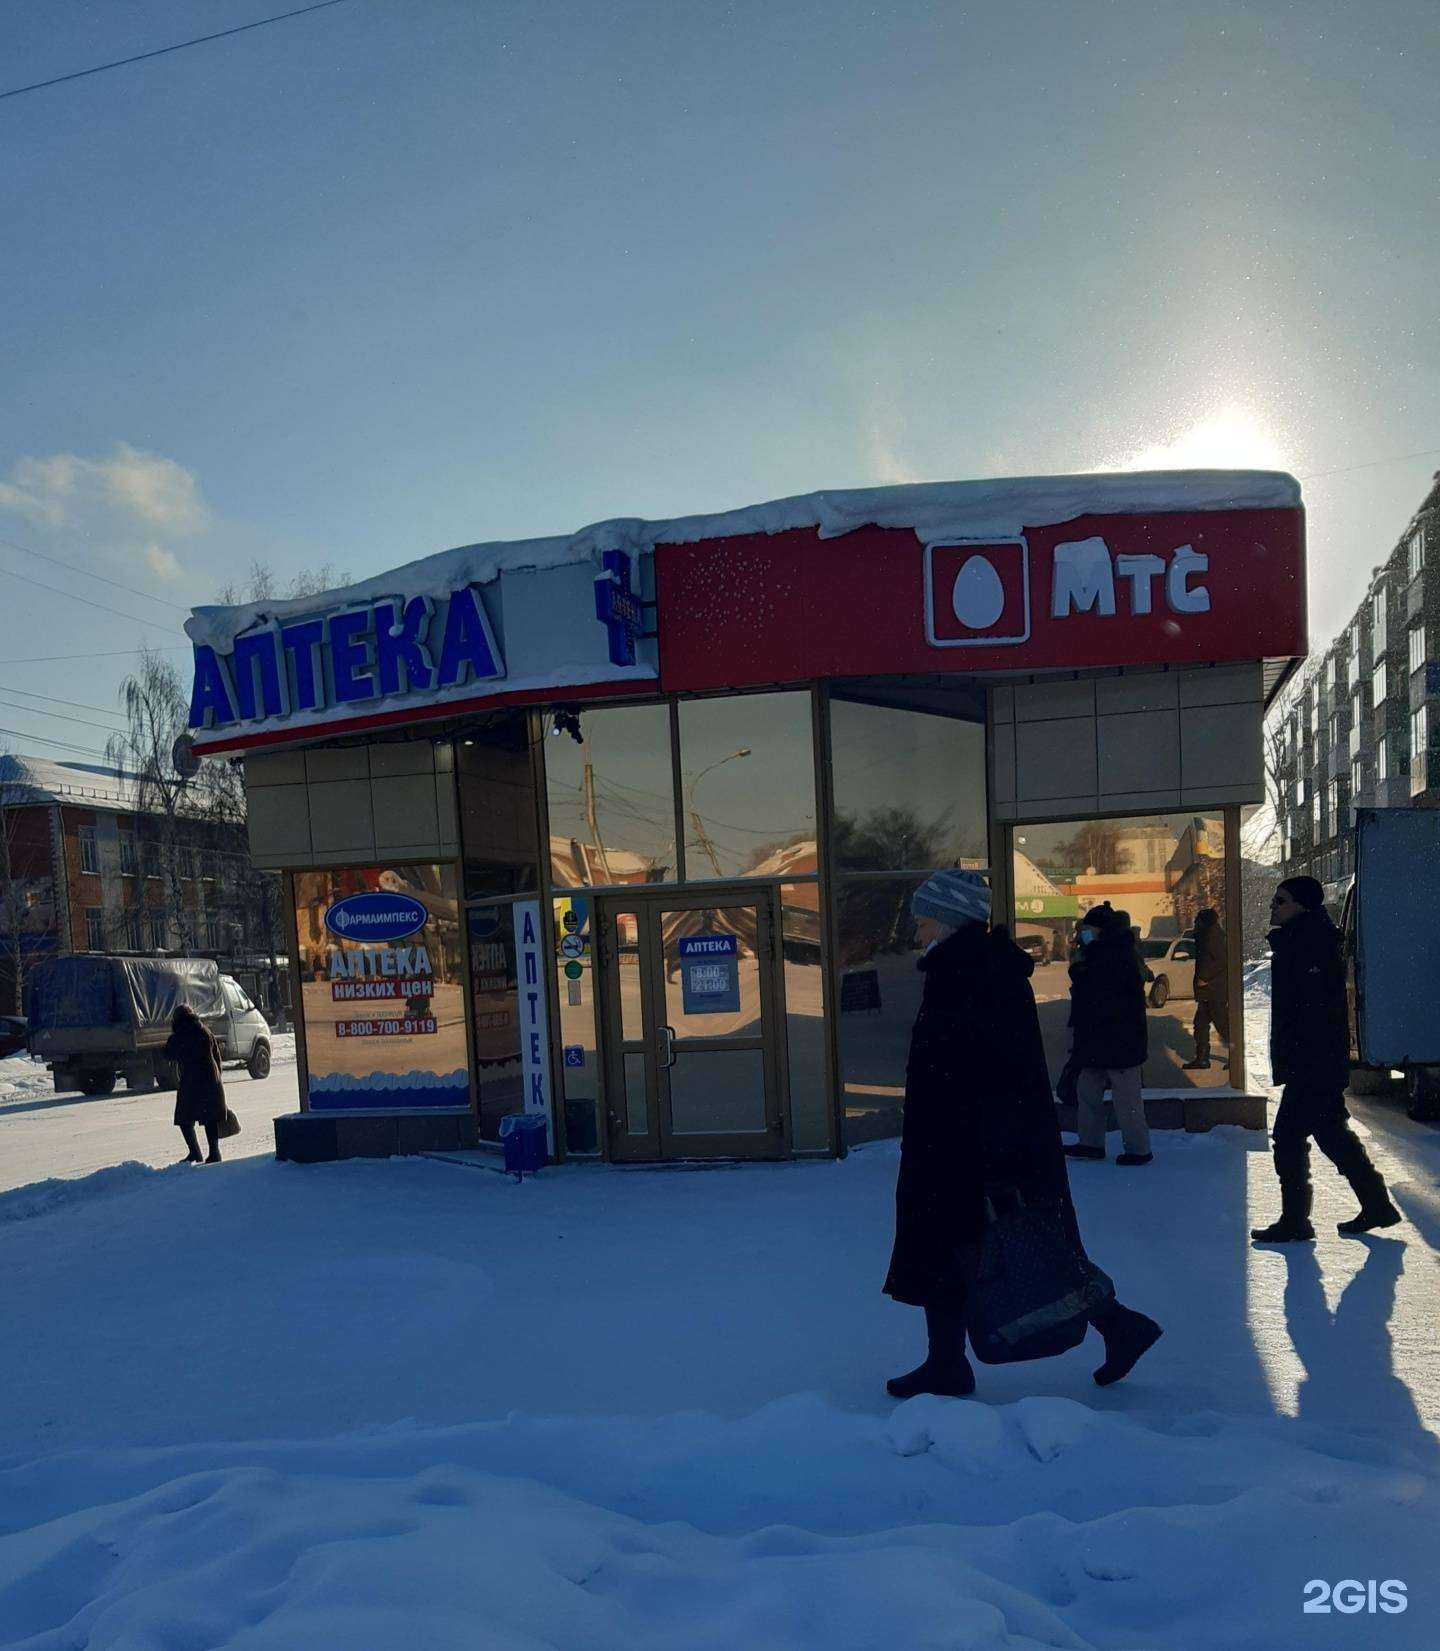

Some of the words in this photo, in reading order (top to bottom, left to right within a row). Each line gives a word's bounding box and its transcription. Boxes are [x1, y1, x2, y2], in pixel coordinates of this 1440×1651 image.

[189, 586, 504, 728] АПТЕКА
[335, 907, 419, 931] ФАРМАИМПЕКС
[686, 940, 732, 953] АПТЕКА
[330, 946, 432, 978] АПТЕКА
[338, 1019, 435, 1037] 8-800-700-9119
